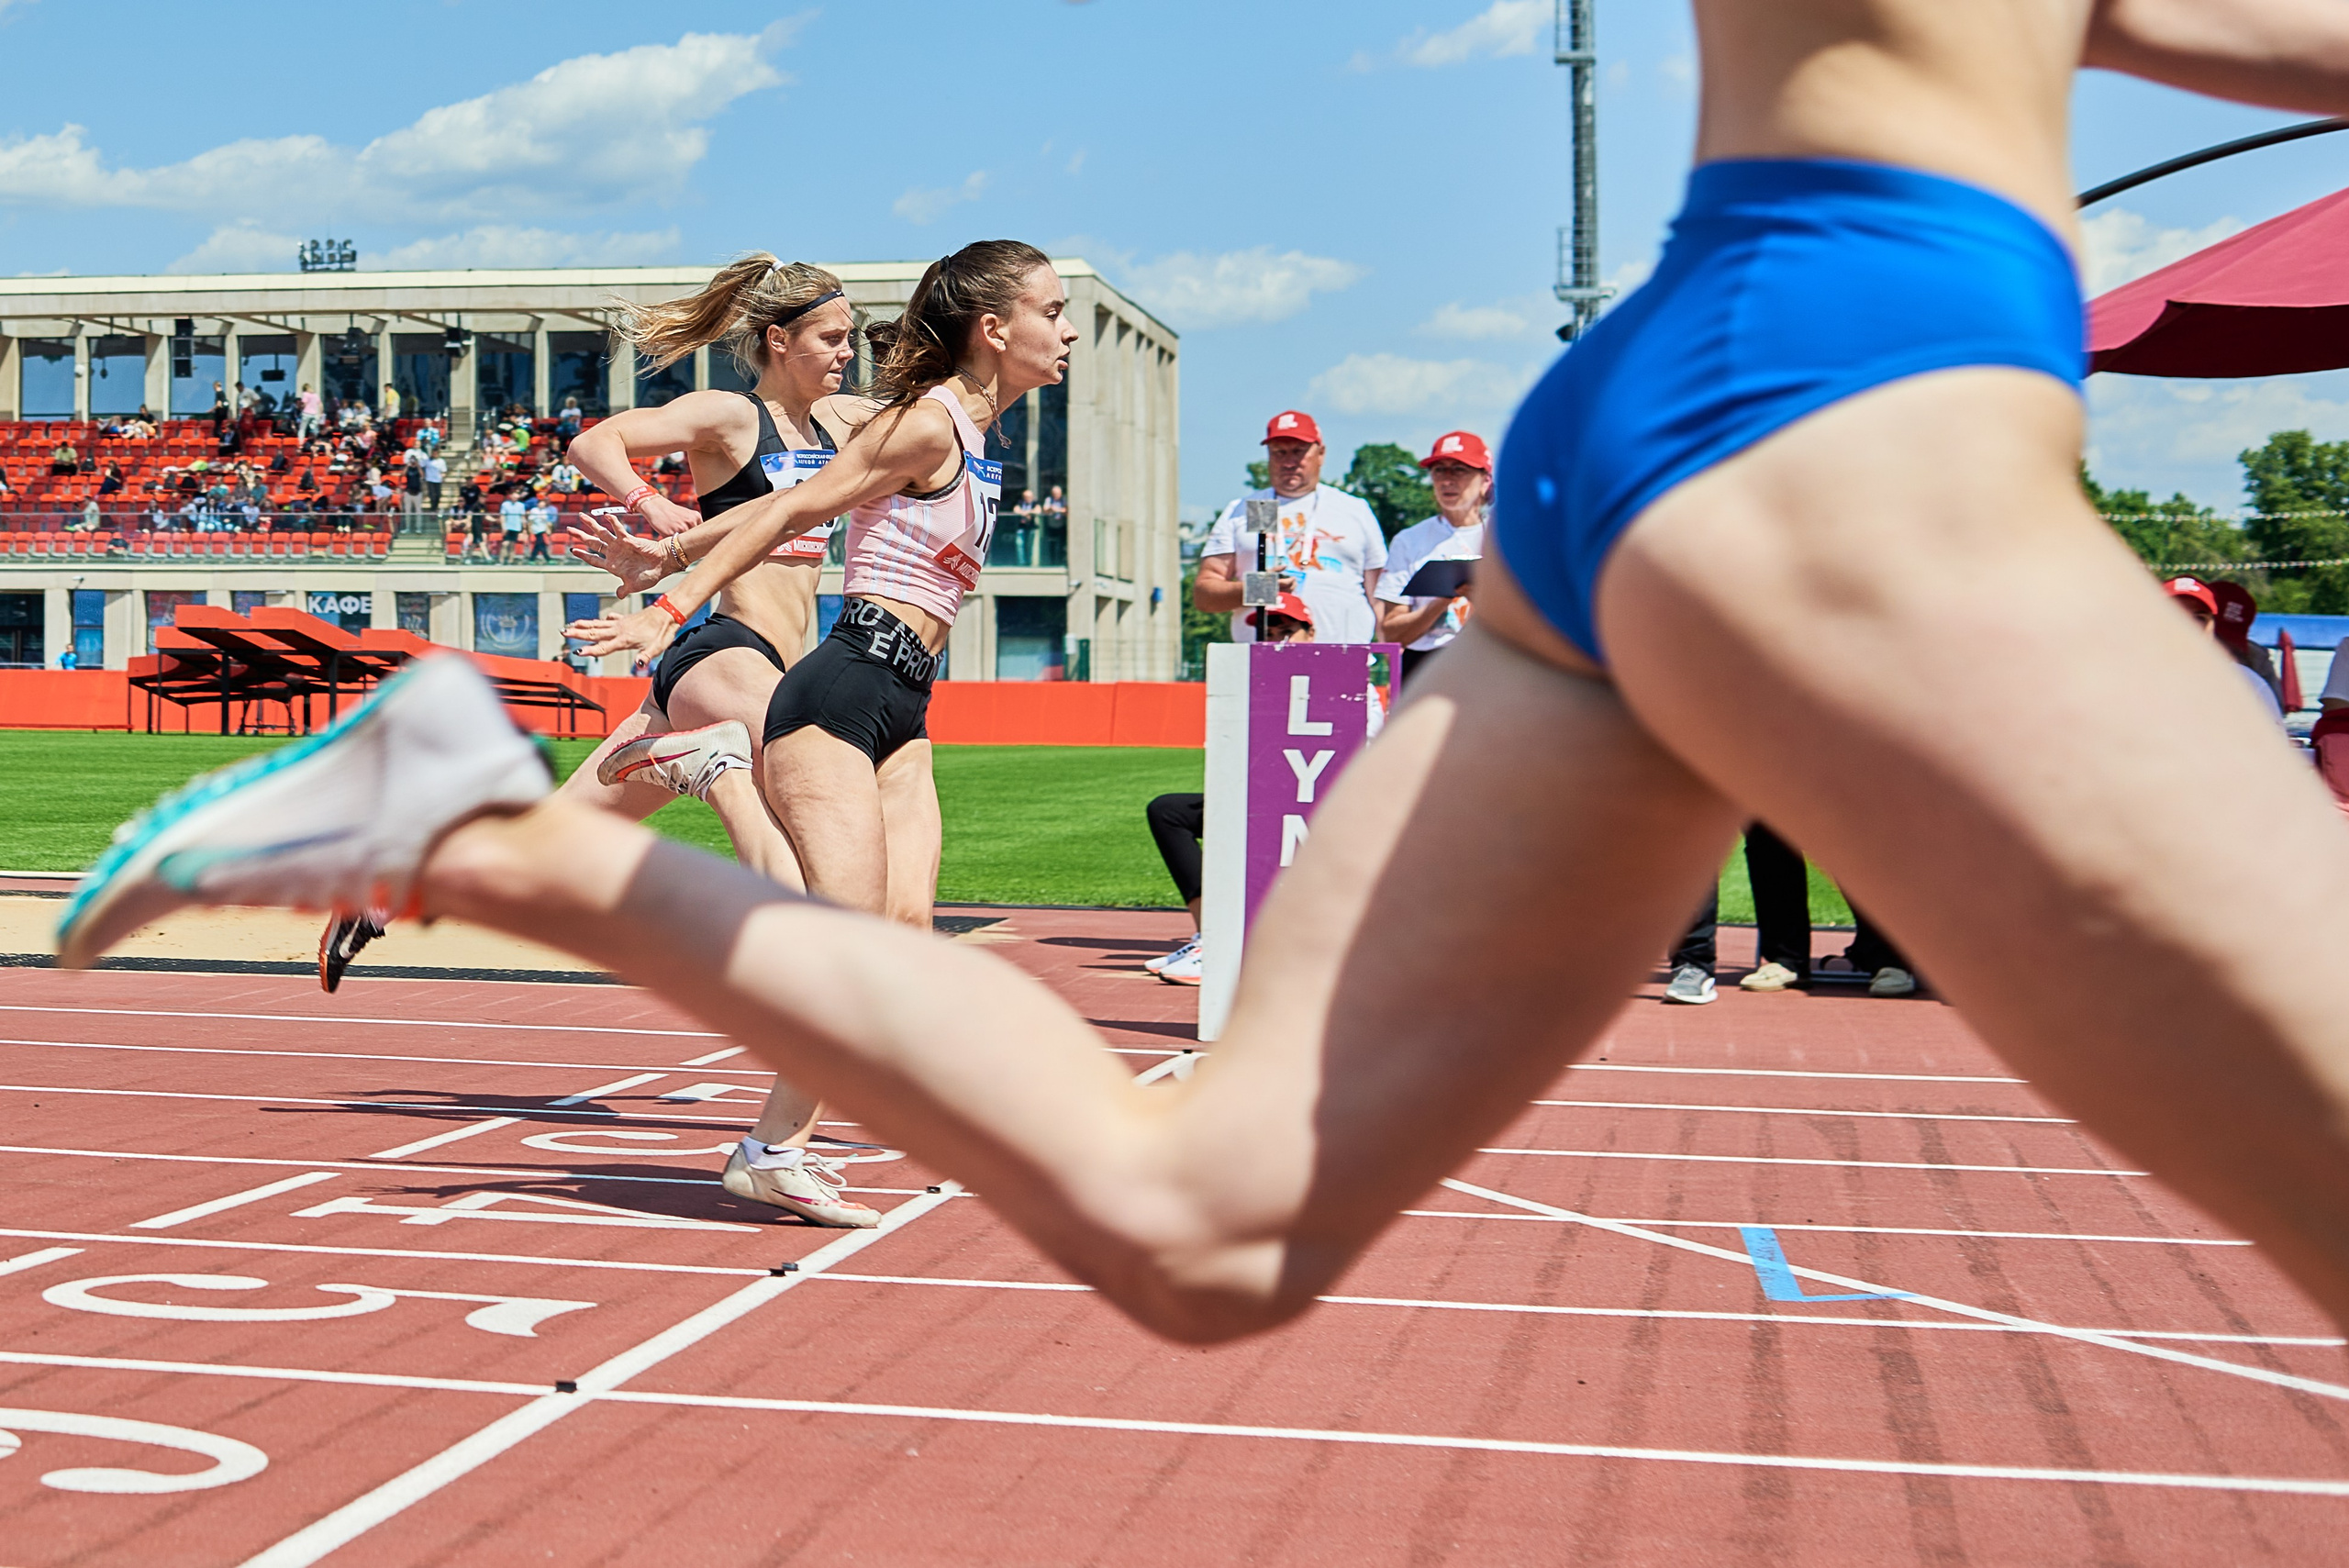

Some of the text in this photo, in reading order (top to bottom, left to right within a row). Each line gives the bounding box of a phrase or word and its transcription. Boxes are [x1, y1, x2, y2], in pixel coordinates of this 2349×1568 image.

[307, 595, 372, 615] КАФЕ
[892, 641, 930, 682] PRO
[42, 1273, 597, 1338] 5
